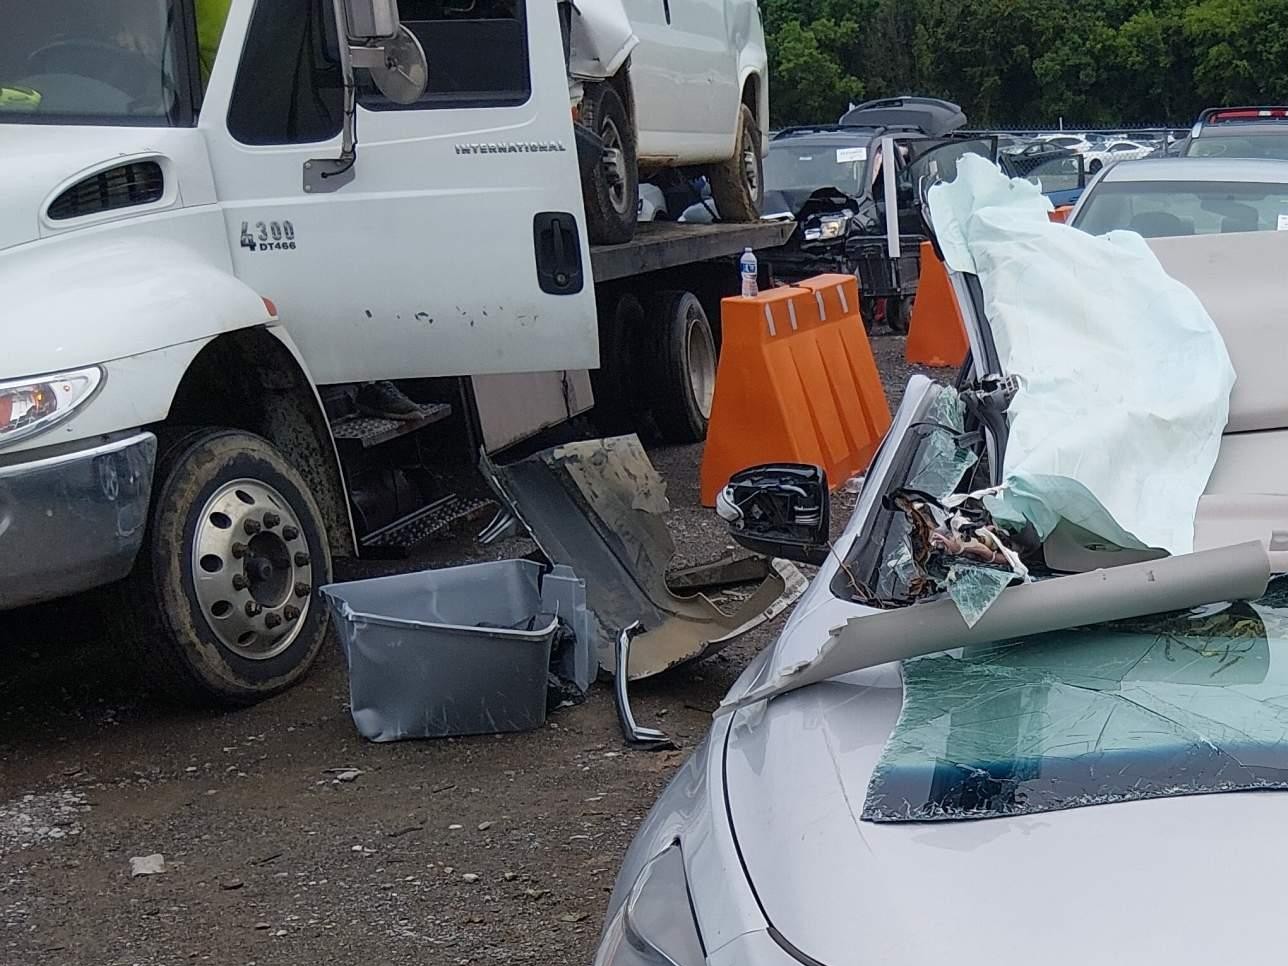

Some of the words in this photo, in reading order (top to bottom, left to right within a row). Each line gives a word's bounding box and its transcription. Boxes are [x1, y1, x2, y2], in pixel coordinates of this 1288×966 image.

[454, 141, 566, 154] INTERNATIONAL
[240, 220, 295, 251] 4300
[259, 241, 296, 251] DT466
